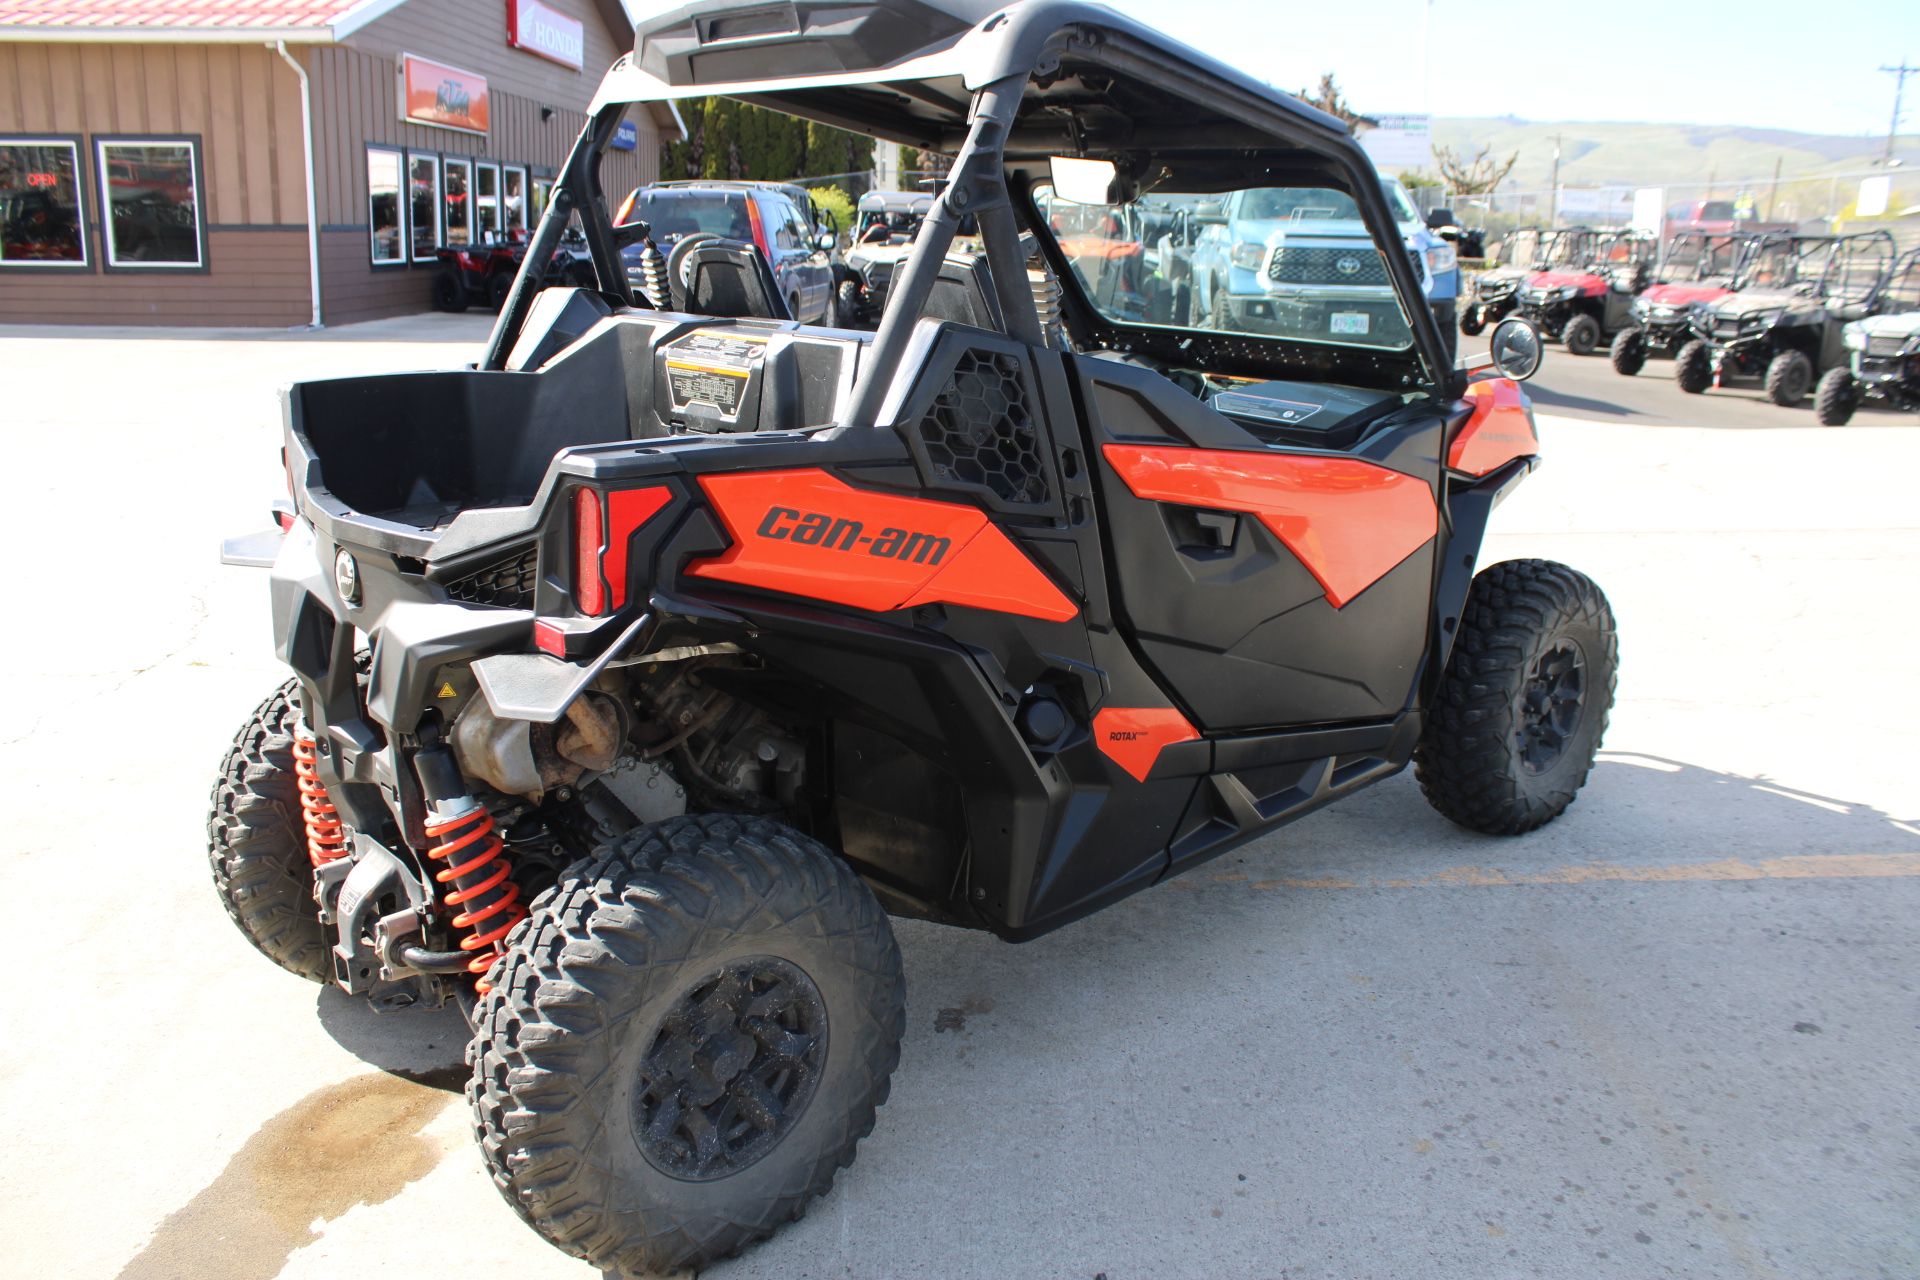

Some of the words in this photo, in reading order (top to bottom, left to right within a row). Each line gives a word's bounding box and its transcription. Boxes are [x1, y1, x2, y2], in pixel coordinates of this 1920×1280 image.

[535, 21, 583, 60] HONDA
[27, 173, 57, 187] OPEN
[1110, 731, 1138, 741] ROTAX
